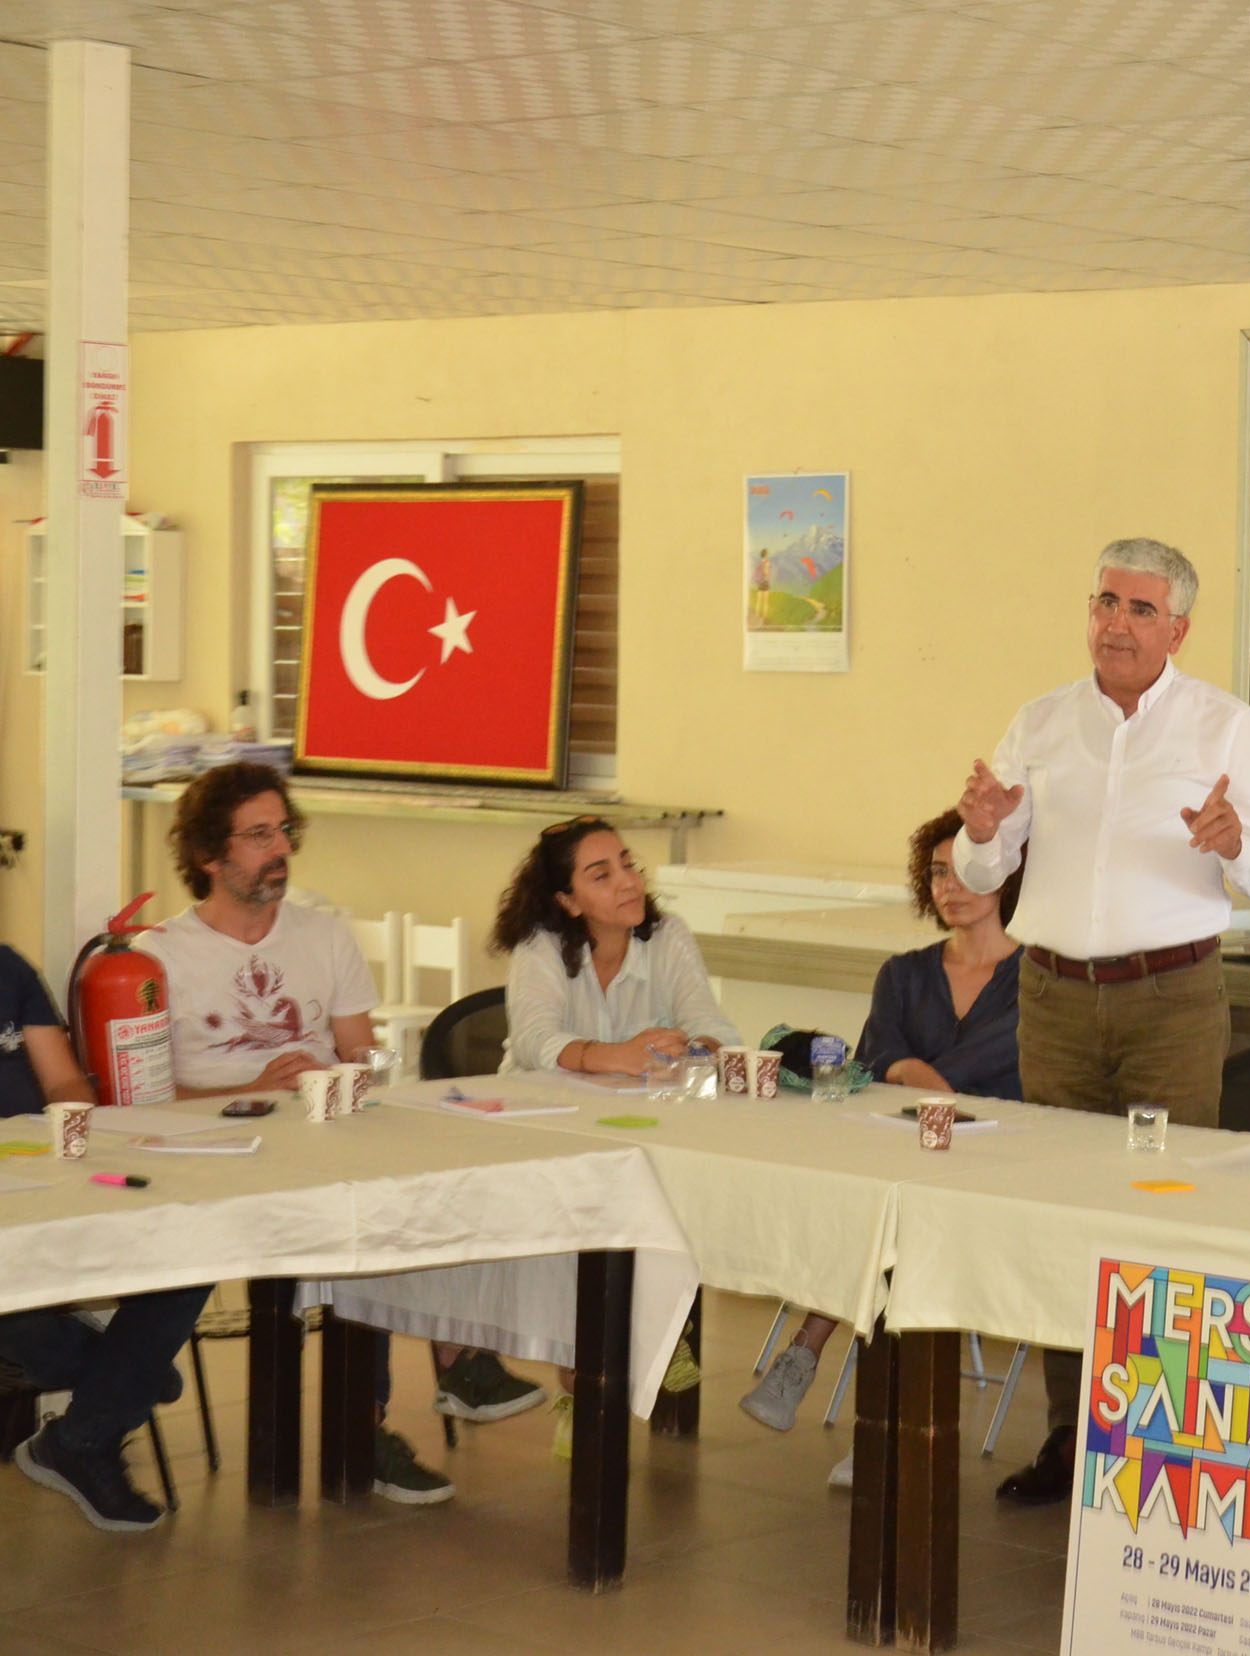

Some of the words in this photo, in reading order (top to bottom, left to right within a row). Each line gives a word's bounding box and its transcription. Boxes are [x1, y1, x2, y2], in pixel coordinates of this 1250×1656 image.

[1123, 1545, 1143, 1570] 28
[1159, 1553, 1180, 1577] 29
[1185, 1558, 1236, 1590] Mayıs
